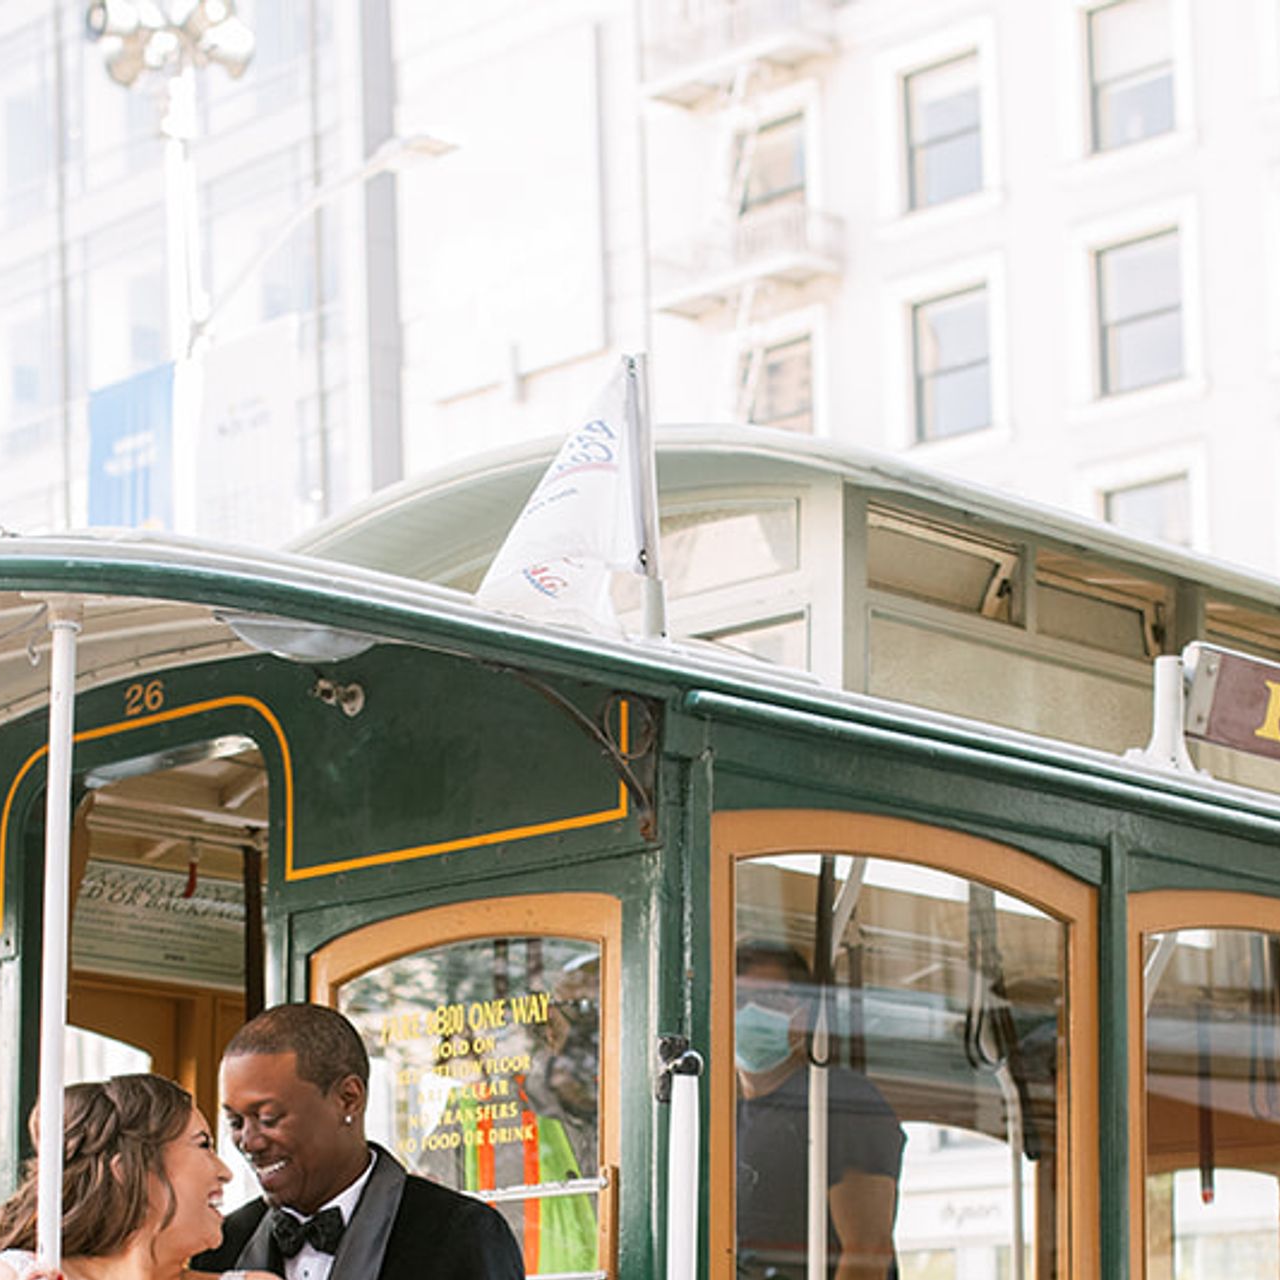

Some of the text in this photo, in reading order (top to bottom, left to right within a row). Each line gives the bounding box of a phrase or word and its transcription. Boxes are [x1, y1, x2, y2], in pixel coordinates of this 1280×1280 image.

[124, 679, 165, 716] 26
[468, 998, 507, 1032] ONE
[510, 992, 551, 1025] WAY
[486, 1054, 532, 1074] FLOOR
[461, 1079, 509, 1100] CLEAR
[421, 1132, 461, 1153] FOOD
[463, 1128, 485, 1145] OR
[488, 1124, 536, 1145] DRINK
